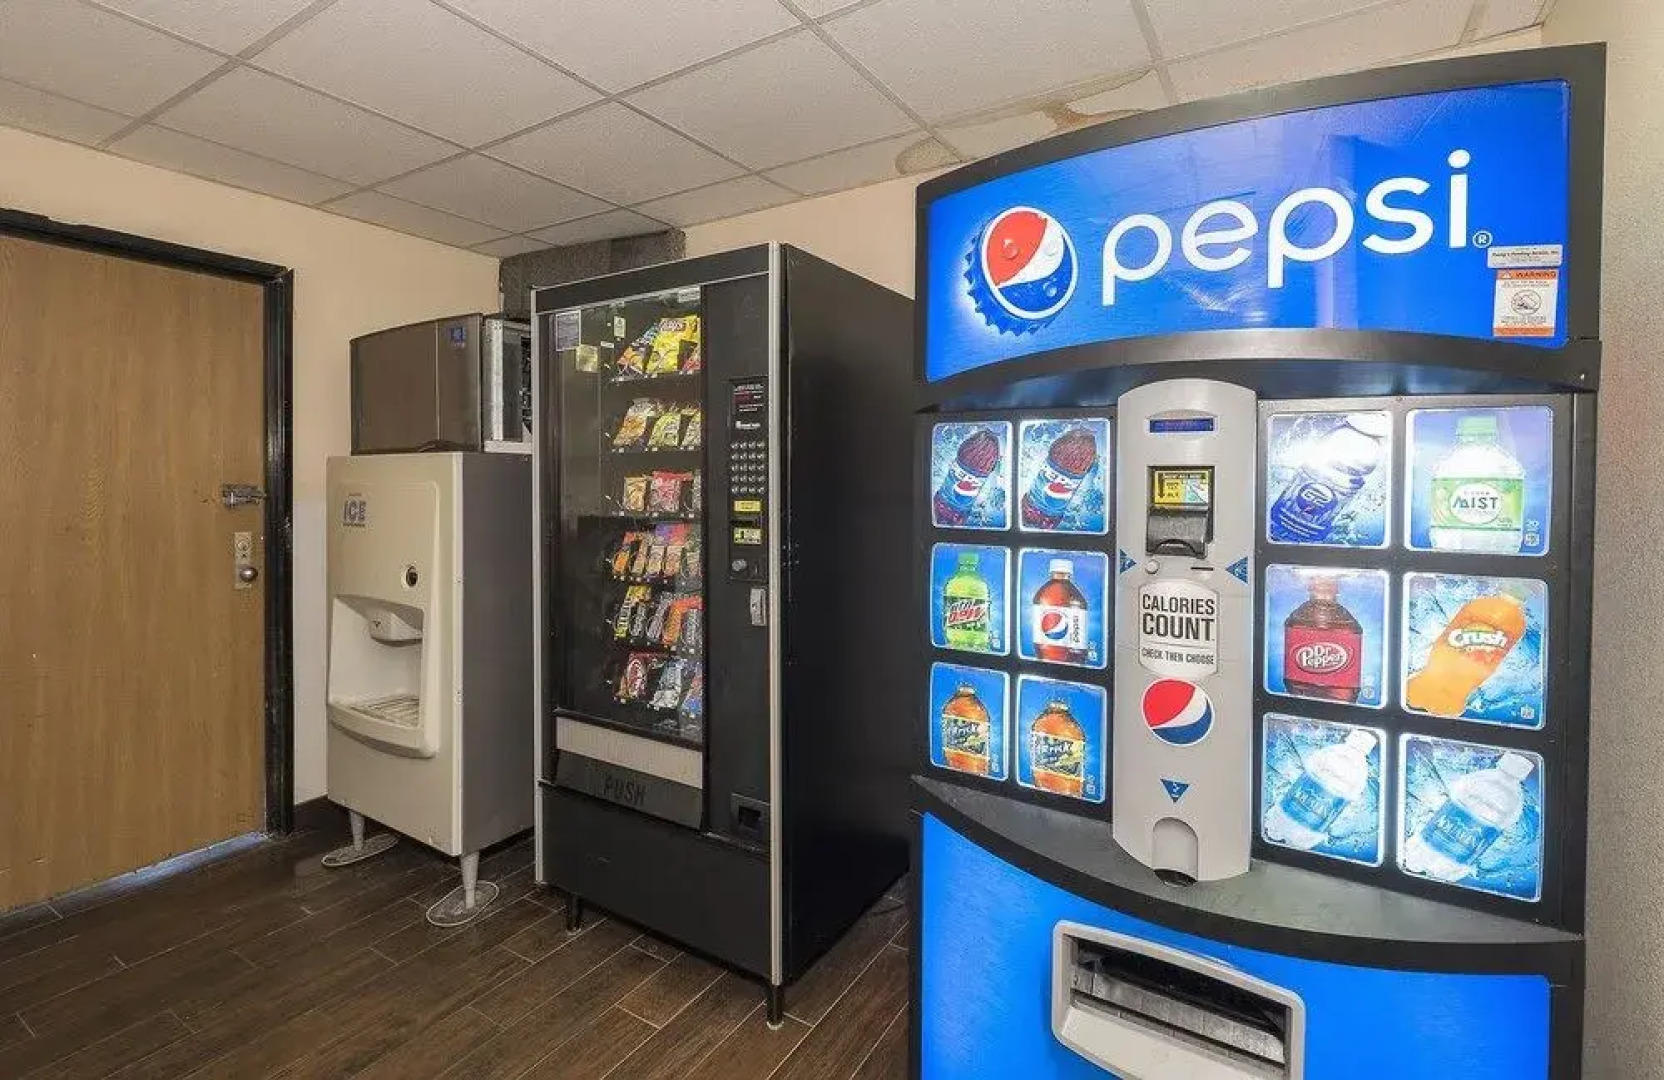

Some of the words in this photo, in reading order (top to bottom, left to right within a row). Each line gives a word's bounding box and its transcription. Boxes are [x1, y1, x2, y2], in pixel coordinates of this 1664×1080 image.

[1102, 149, 1471, 306] pepsi
[1143, 594, 1215, 615] CALORIES
[1143, 612, 1214, 641] COUNT
[1447, 629, 1506, 648] Crush
[1141, 646, 1164, 660] CHECK
[1164, 650, 1184, 662] THEN
[1186, 653, 1214, 665] CHOOSE
